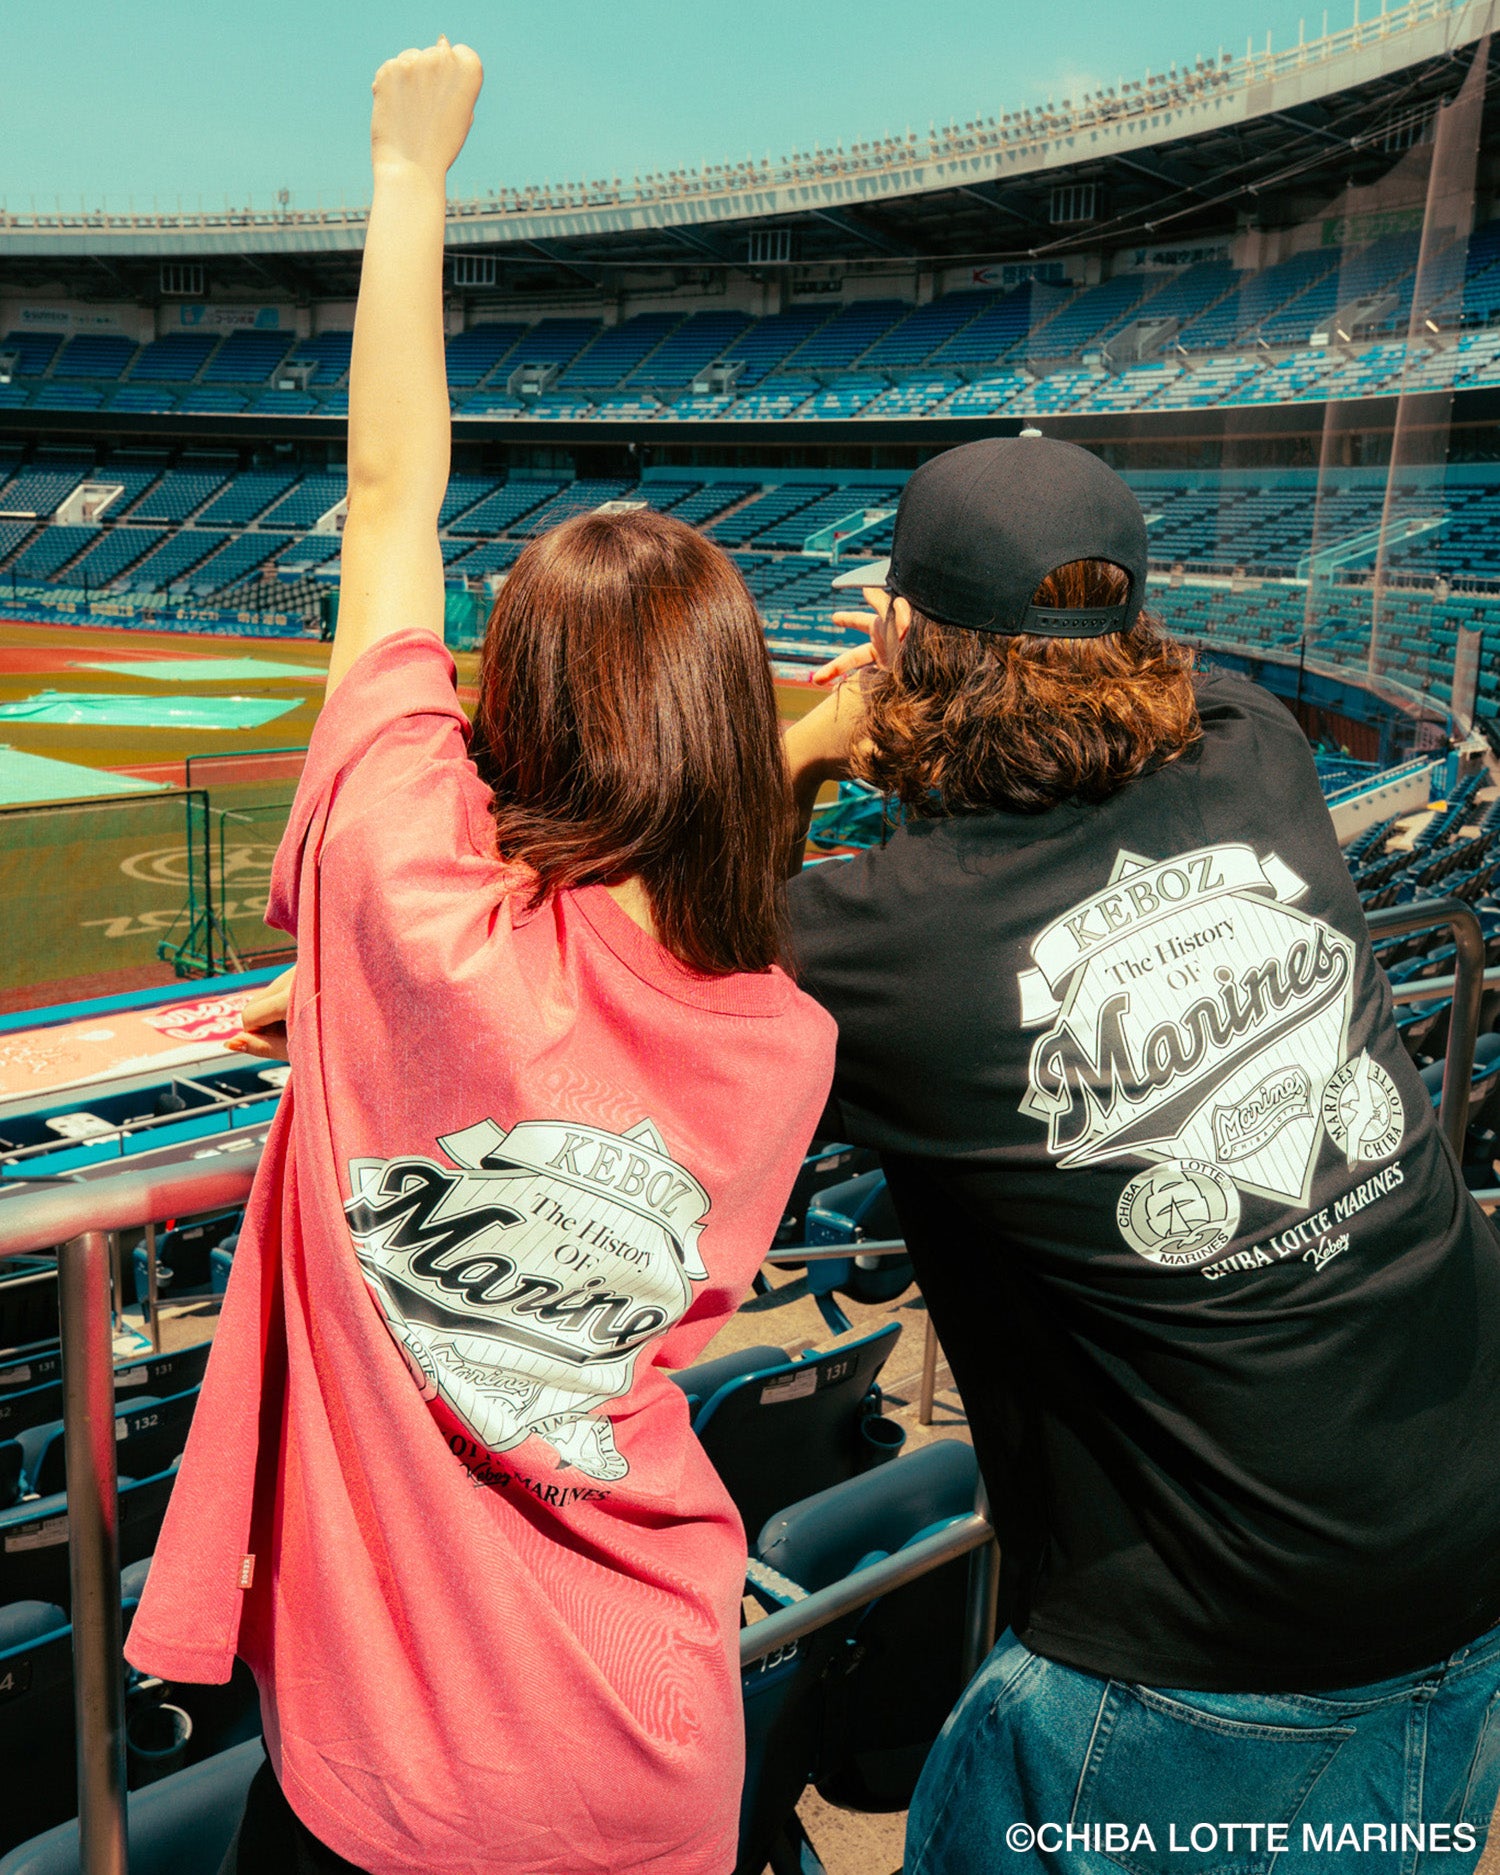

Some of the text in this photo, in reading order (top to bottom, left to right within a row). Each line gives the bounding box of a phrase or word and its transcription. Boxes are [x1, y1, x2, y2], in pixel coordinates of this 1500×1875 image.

[1063, 856, 1225, 953] KEBOZ
[1105, 917, 1236, 986] The History
[1166, 964, 1204, 991] OF
[1029, 918, 1353, 1155] Marines
[1324, 1064, 1354, 1141] MARINES
[1373, 1066, 1402, 1116] LOTTE
[1218, 1071, 1308, 1160] Marines
[1364, 1126, 1402, 1159] CHIBA
[546, 1132, 692, 1218] KEBOZ
[1180, 1161, 1226, 1184] LOTTE
[531, 1193, 578, 1231] The
[1119, 1183, 1141, 1228] CHIBA
[1201, 1161, 1405, 1281] CHIBA LOTTE MARINES
[553, 1243, 601, 1275] OF
[1160, 1232, 1229, 1265] MARINES
[154, 1363, 173, 1376] 131
[403, 1333, 436, 1380] LOTTE
[826, 1361, 849, 1381] 131
[134, 1414, 159, 1431] 132
